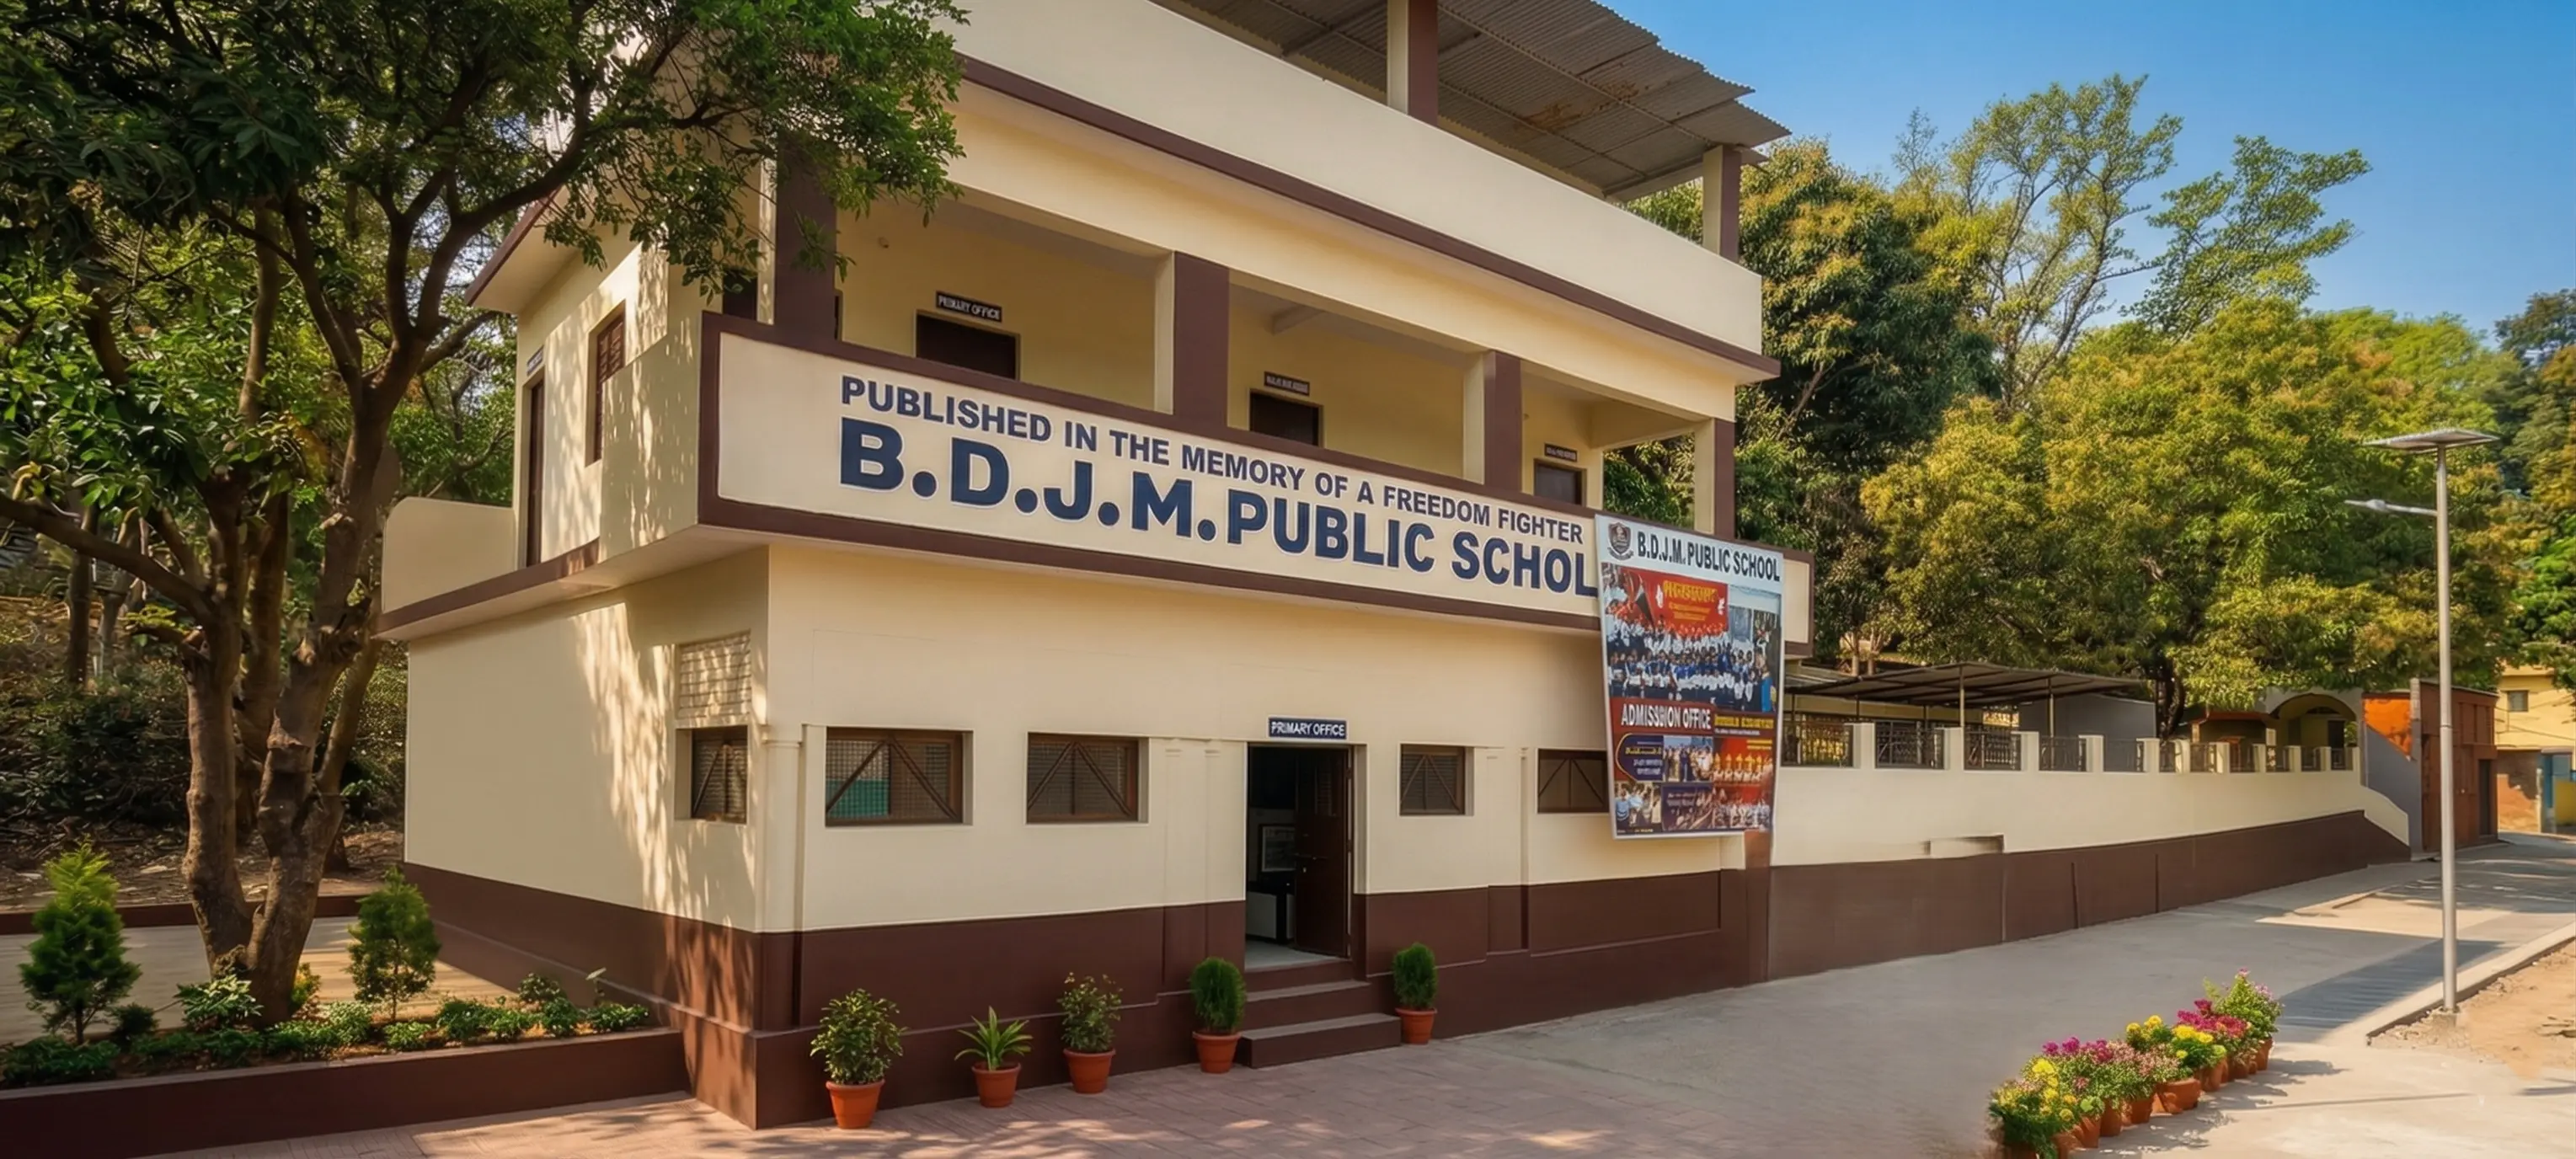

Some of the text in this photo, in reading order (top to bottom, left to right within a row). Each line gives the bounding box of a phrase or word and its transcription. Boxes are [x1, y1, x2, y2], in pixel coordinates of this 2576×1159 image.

[842, 375, 1583, 544] PUBLISHED IN THE MEMORY OF A FREEDOM FIGHTER
[1451, 531, 1598, 597] SCHOL
[1687, 542, 1731, 573] PUBLIC
[1733, 552, 1780, 581] SCHOOL
[1270, 721, 1345, 736] PRIMARY OFFICE
[1682, 708, 1712, 730] OFFICE
